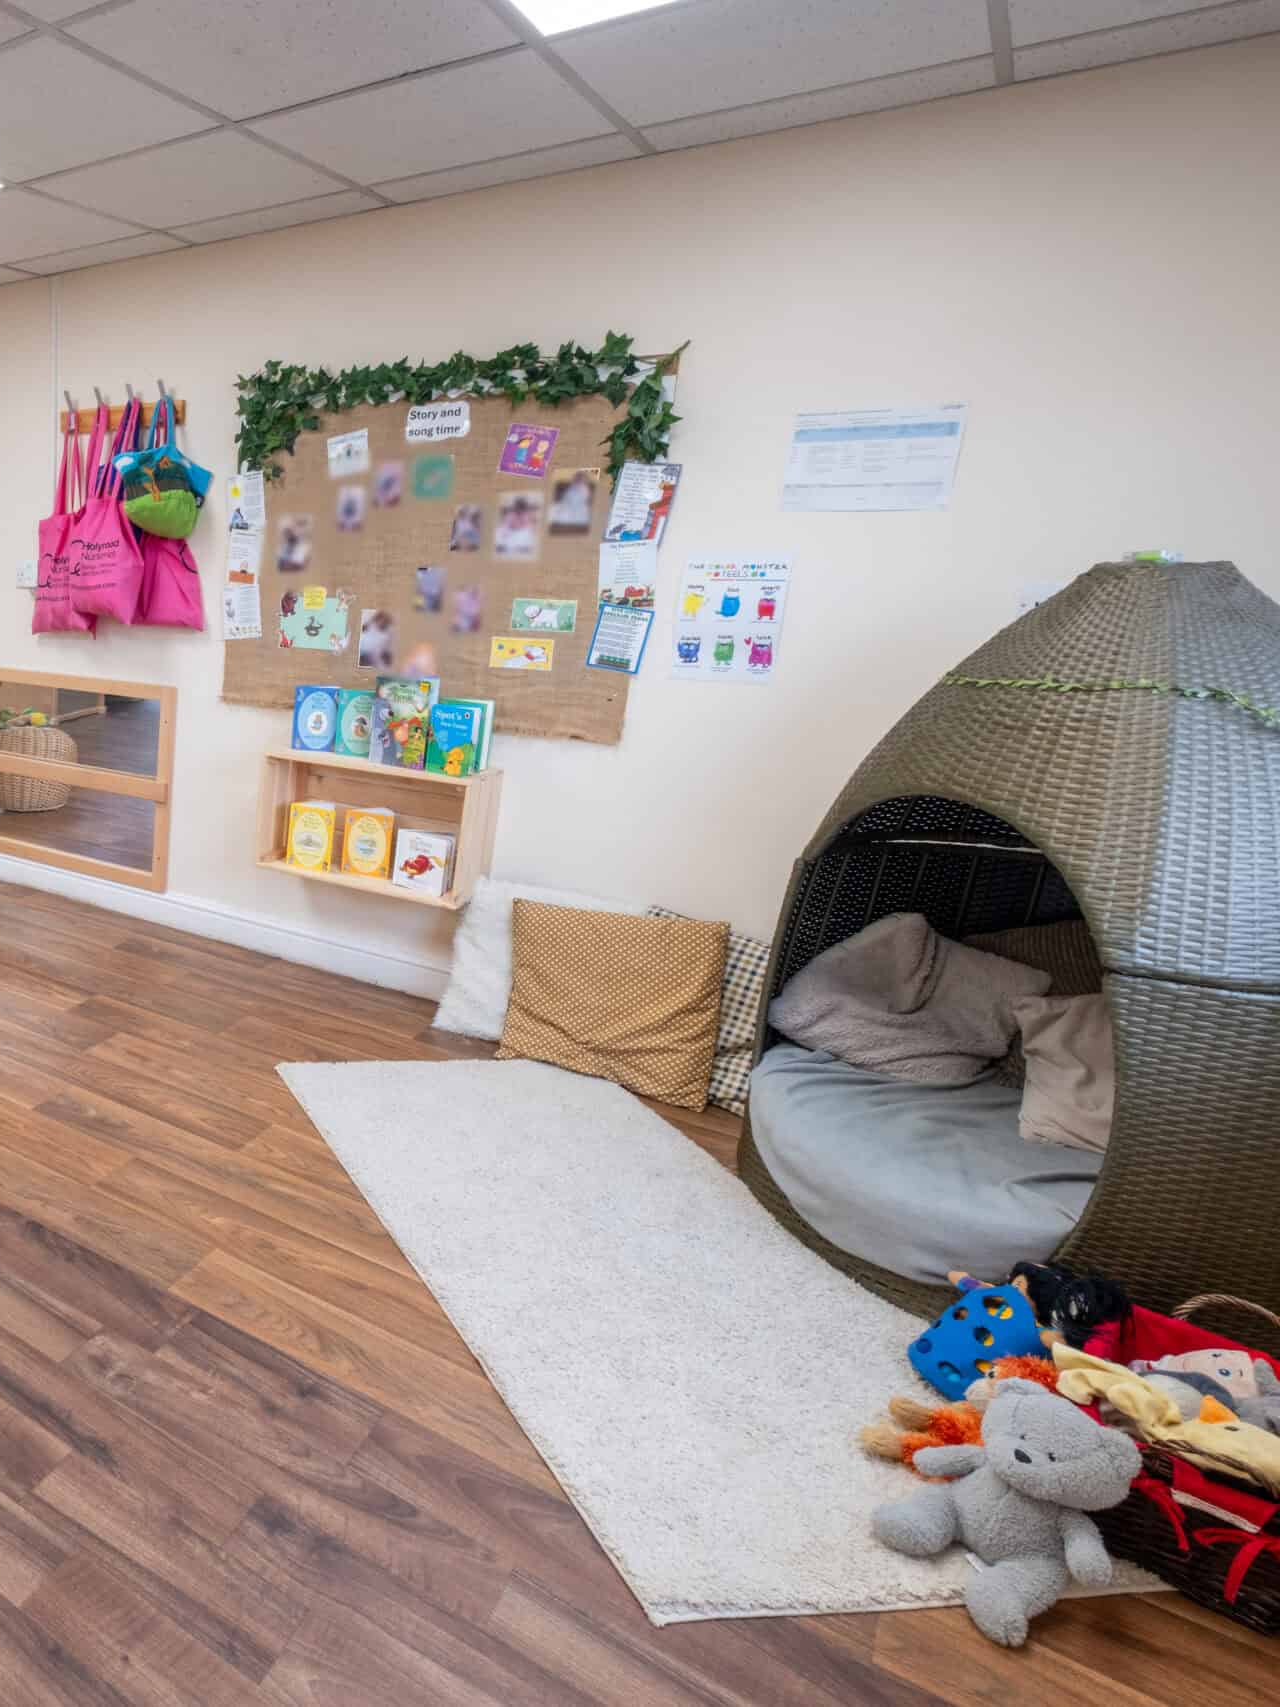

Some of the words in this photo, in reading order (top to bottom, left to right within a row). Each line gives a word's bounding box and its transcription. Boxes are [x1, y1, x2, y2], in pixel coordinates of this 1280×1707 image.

[409, 409, 438, 420] Story
[440, 407, 462, 417] and
[408, 427, 434, 437] song
[436, 425, 461, 435] time
